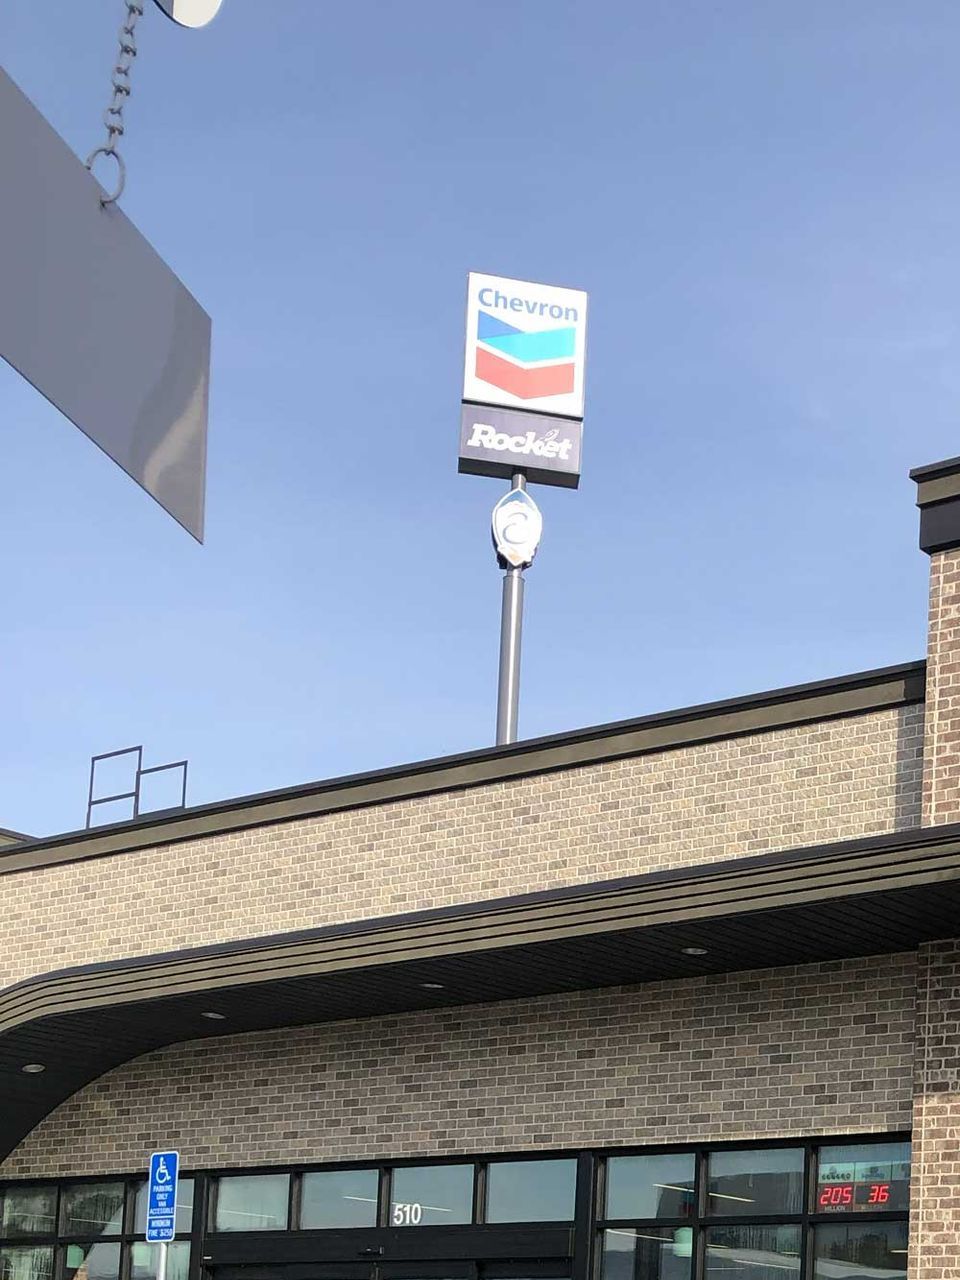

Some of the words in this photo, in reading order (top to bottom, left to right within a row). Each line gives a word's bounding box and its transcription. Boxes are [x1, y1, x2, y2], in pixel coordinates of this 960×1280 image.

[478, 287, 579, 322] Chevron
[466, 422, 573, 461] Rocket
[152, 1184, 173, 1193] PARKING
[820, 1186, 853, 1205] 205
[867, 1184, 890, 1203] 36
[156, 1193, 169, 1201] ONLY
[149, 1207, 174, 1215] ACCESSIBLE
[393, 1203, 422, 1225] 510
[159, 1228, 173, 1237] $250
